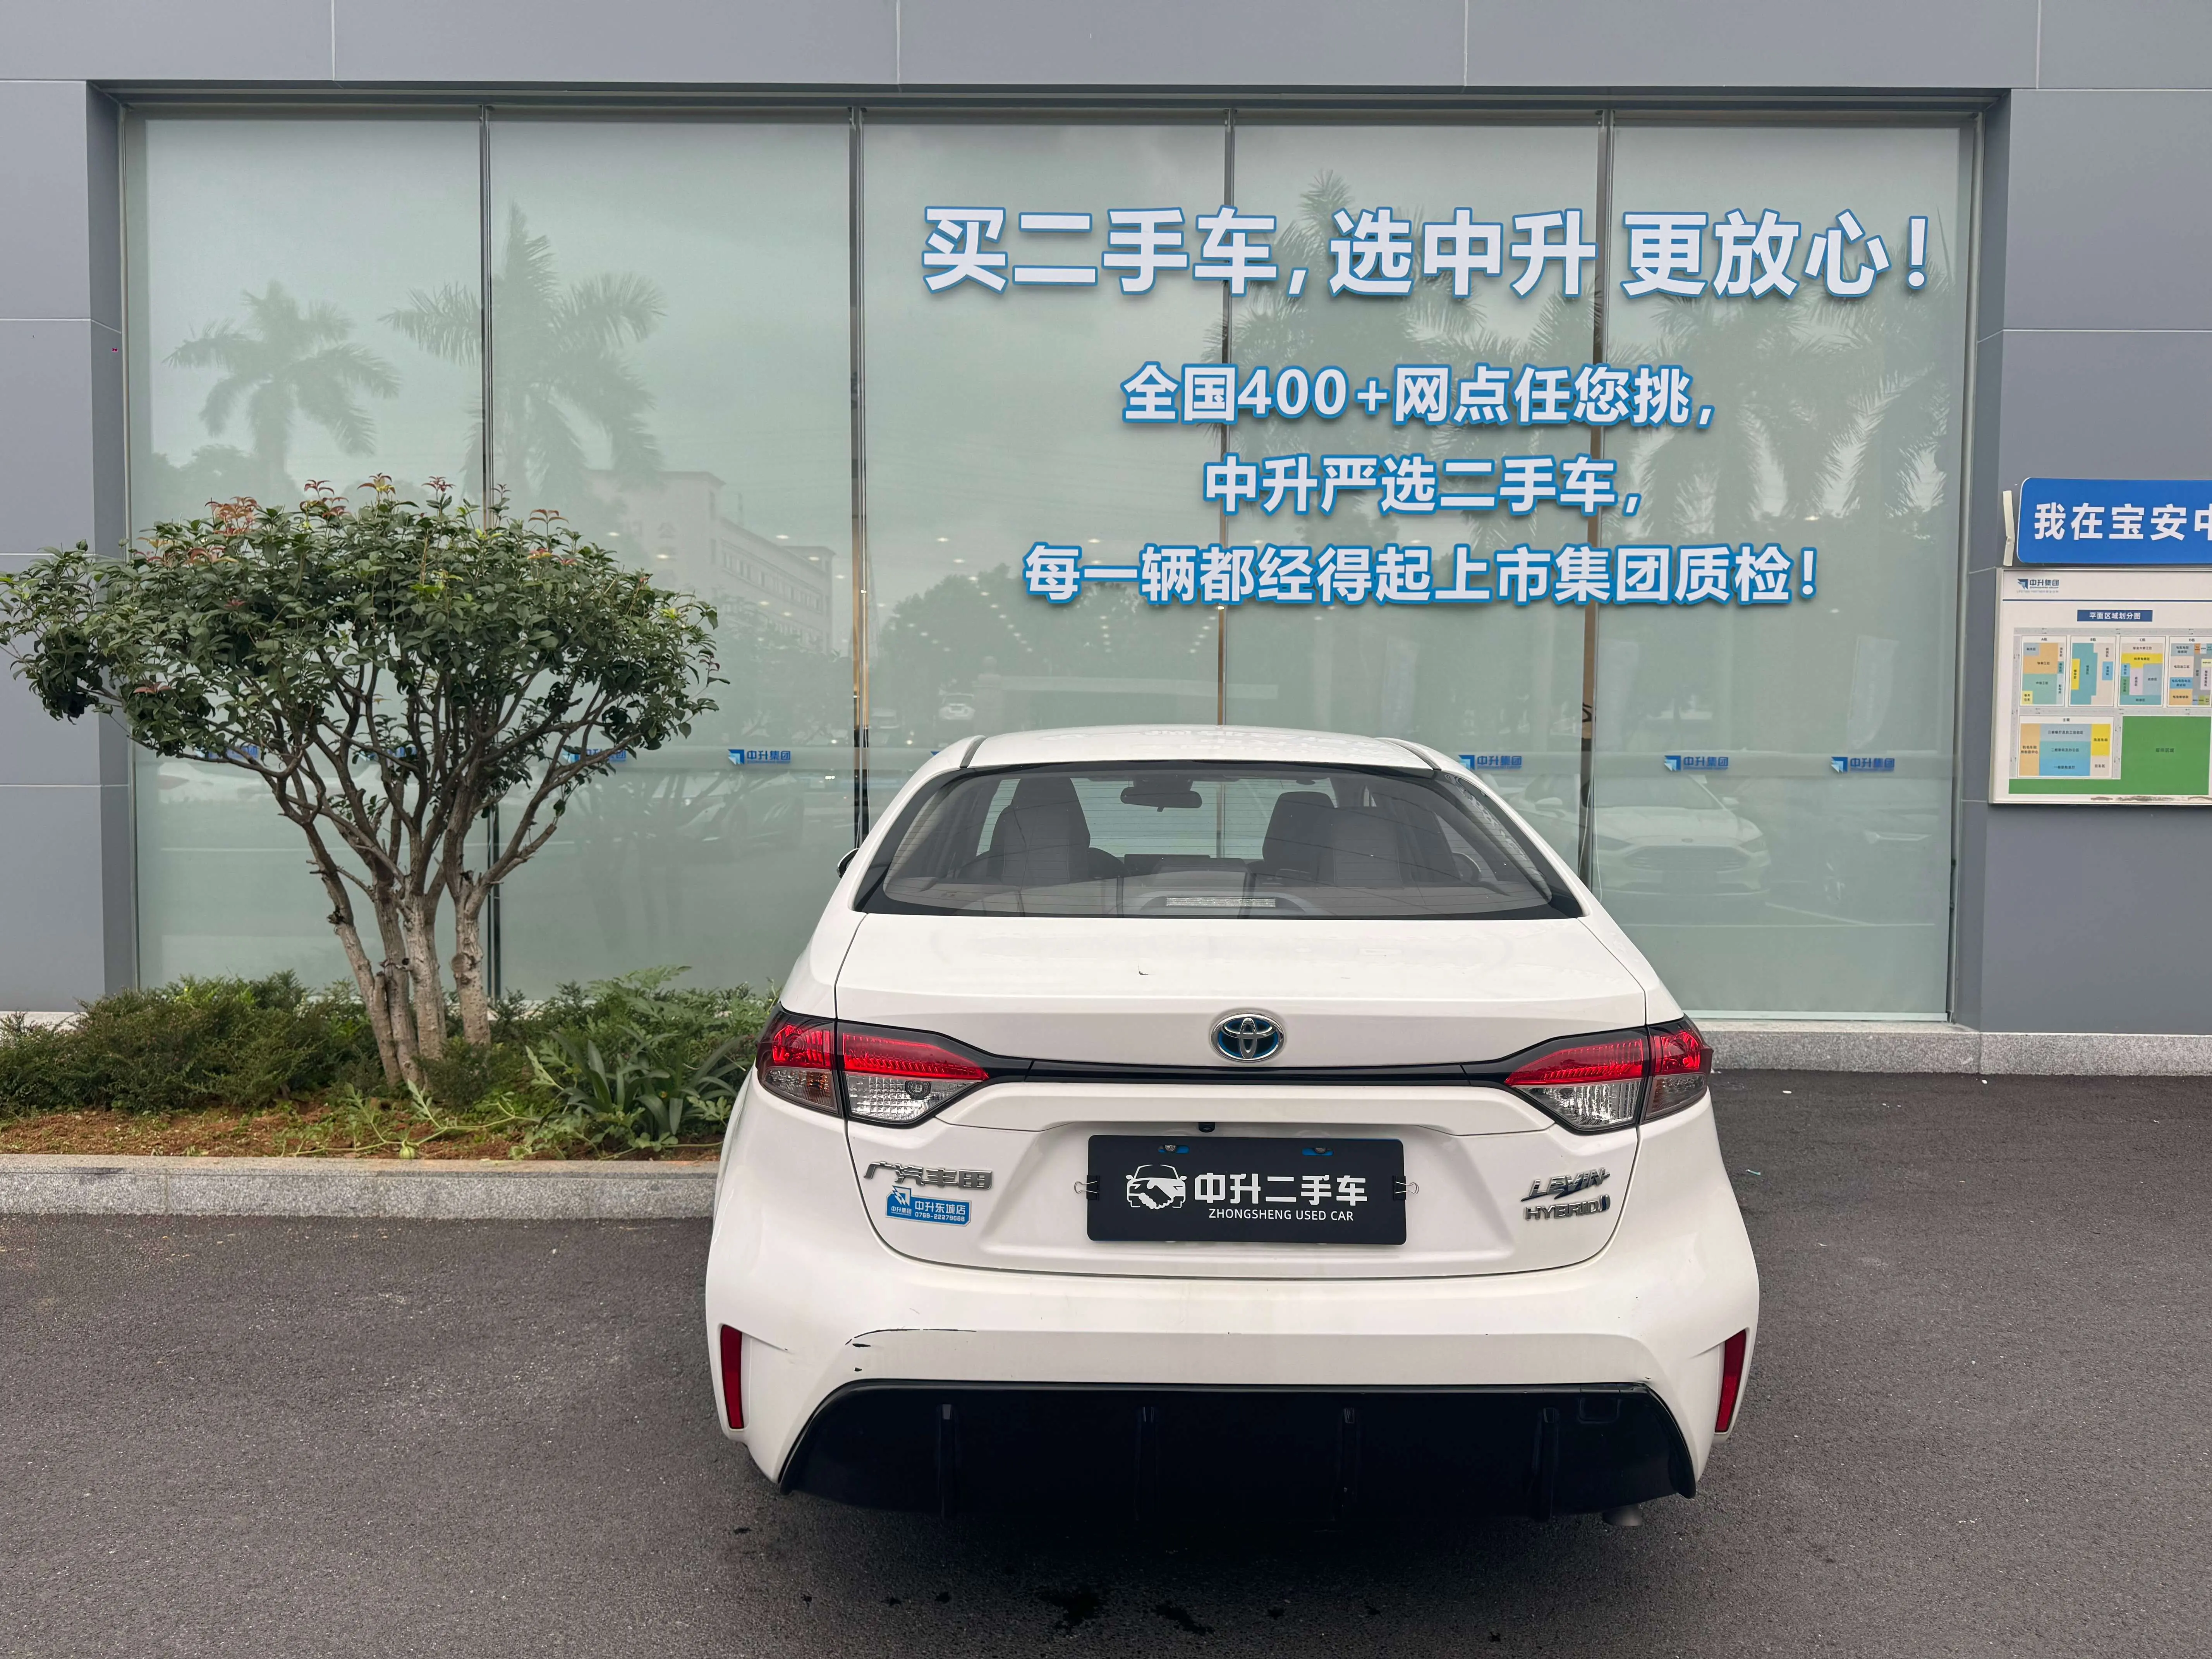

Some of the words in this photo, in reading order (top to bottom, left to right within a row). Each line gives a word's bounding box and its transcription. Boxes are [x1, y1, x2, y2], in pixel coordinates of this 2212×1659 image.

[1203, 452, 1641, 516] 中升严选二手车，
[747, 750, 791, 760] 中升集团
[1477, 756, 1522, 765] 中升集团
[1683, 756, 1729, 766] 中升集团
[1850, 757, 1895, 768] 中升集团
[863, 1160, 993, 1190] 广汽丰田
[1194, 1172, 1368, 1206] 中升二手车
[1521, 1167, 1611, 1201] LEVIN
[915, 1200, 966, 1215] 中升东城店
[1209, 1208, 1292, 1221] ZHONGSHENG
[1296, 1209, 1327, 1221] USED
[1331, 1210, 1354, 1221] CAR
[1525, 1200, 1599, 1221] HYBRID
